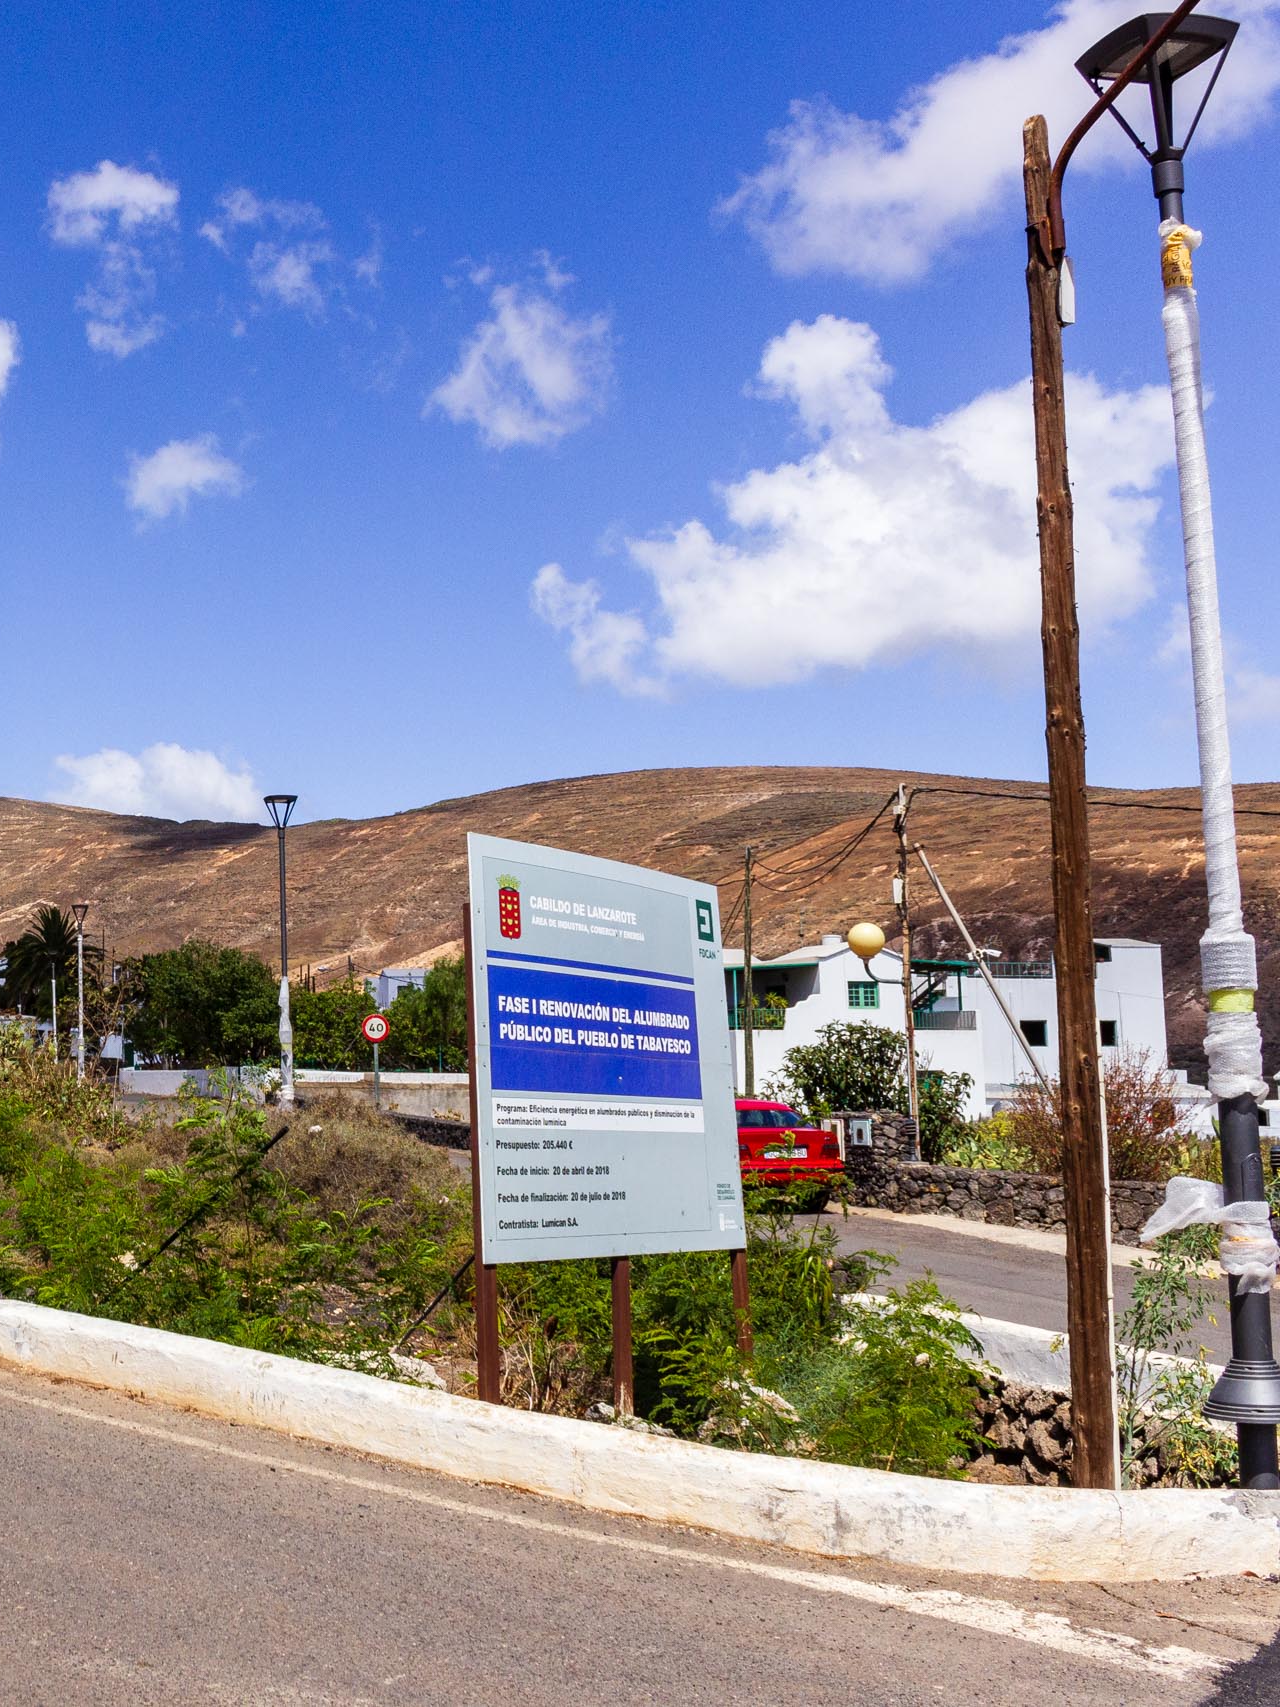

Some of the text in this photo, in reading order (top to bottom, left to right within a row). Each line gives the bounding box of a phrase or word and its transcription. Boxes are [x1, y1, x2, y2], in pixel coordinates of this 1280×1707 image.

[530, 895, 637, 926] CABILDO DE LANZAROTE
[549, 918, 557, 928] DE
[498, 995, 689, 1030] FASE I RENOVACIÓN DEL ALUMBRADO
[369, 1024, 383, 1032] 40
[500, 1020, 691, 1054] PÚBLICO DEL PUEBLO DE TABAYESCO
[496, 1104, 528, 1115] Programa:
[529, 1105, 558, 1114] Eficiencia
[559, 1106, 588, 1116] energética
[597, 1108, 626, 1116] alumbrados
[497, 1117, 541, 1125] contaminación
[496, 1140, 573, 1151] Presupuesto: 205.440 €
[497, 1166, 609, 1176] Fecha de inicio: 20 de abril de 2018
[498, 1191, 626, 1203] Fecha de finalización: 20 de julio de 2018
[499, 1218, 578, 1230] Contratista: Lumican S.A.
